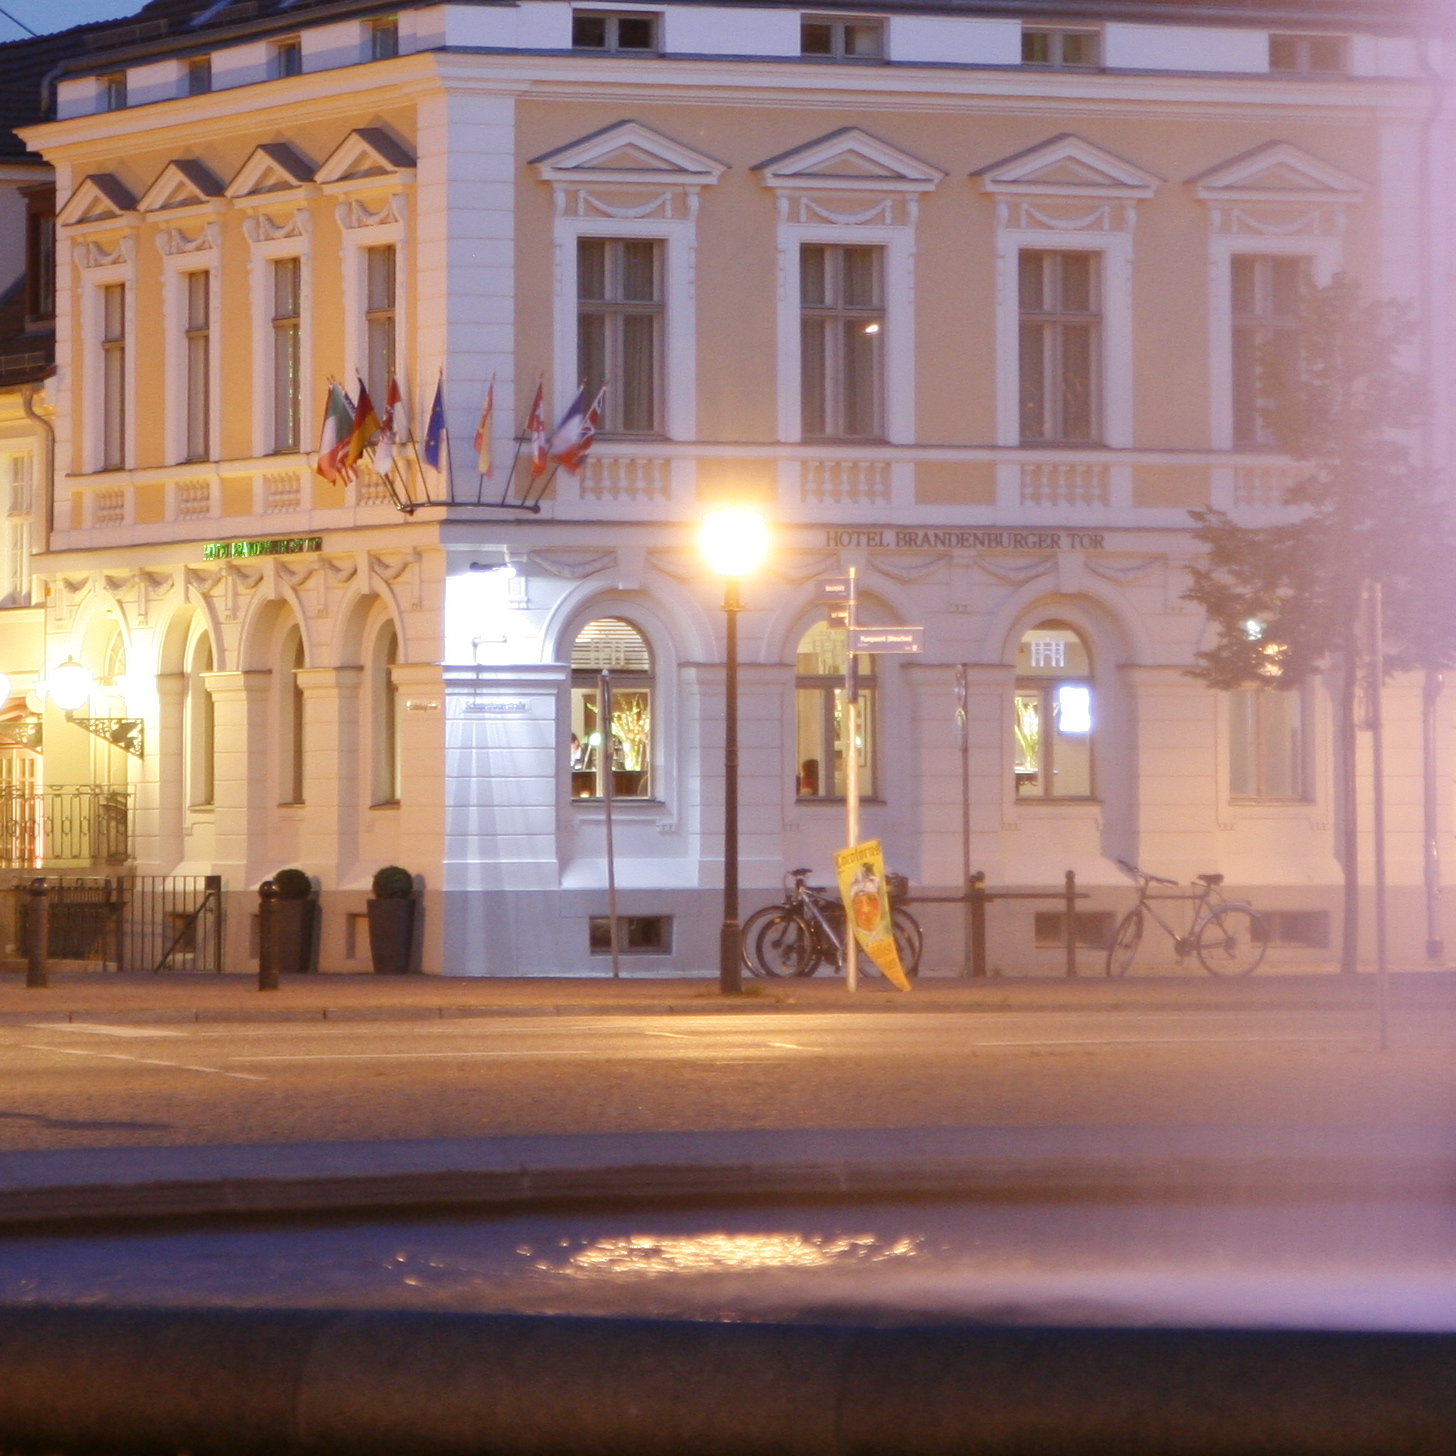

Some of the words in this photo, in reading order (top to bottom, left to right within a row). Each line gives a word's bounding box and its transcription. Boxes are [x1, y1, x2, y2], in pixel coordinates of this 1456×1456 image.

[825, 530, 889, 548] HOTEL
[896, 531, 1062, 549] BRANDENBURGER
[1066, 533, 1105, 549] TOR
